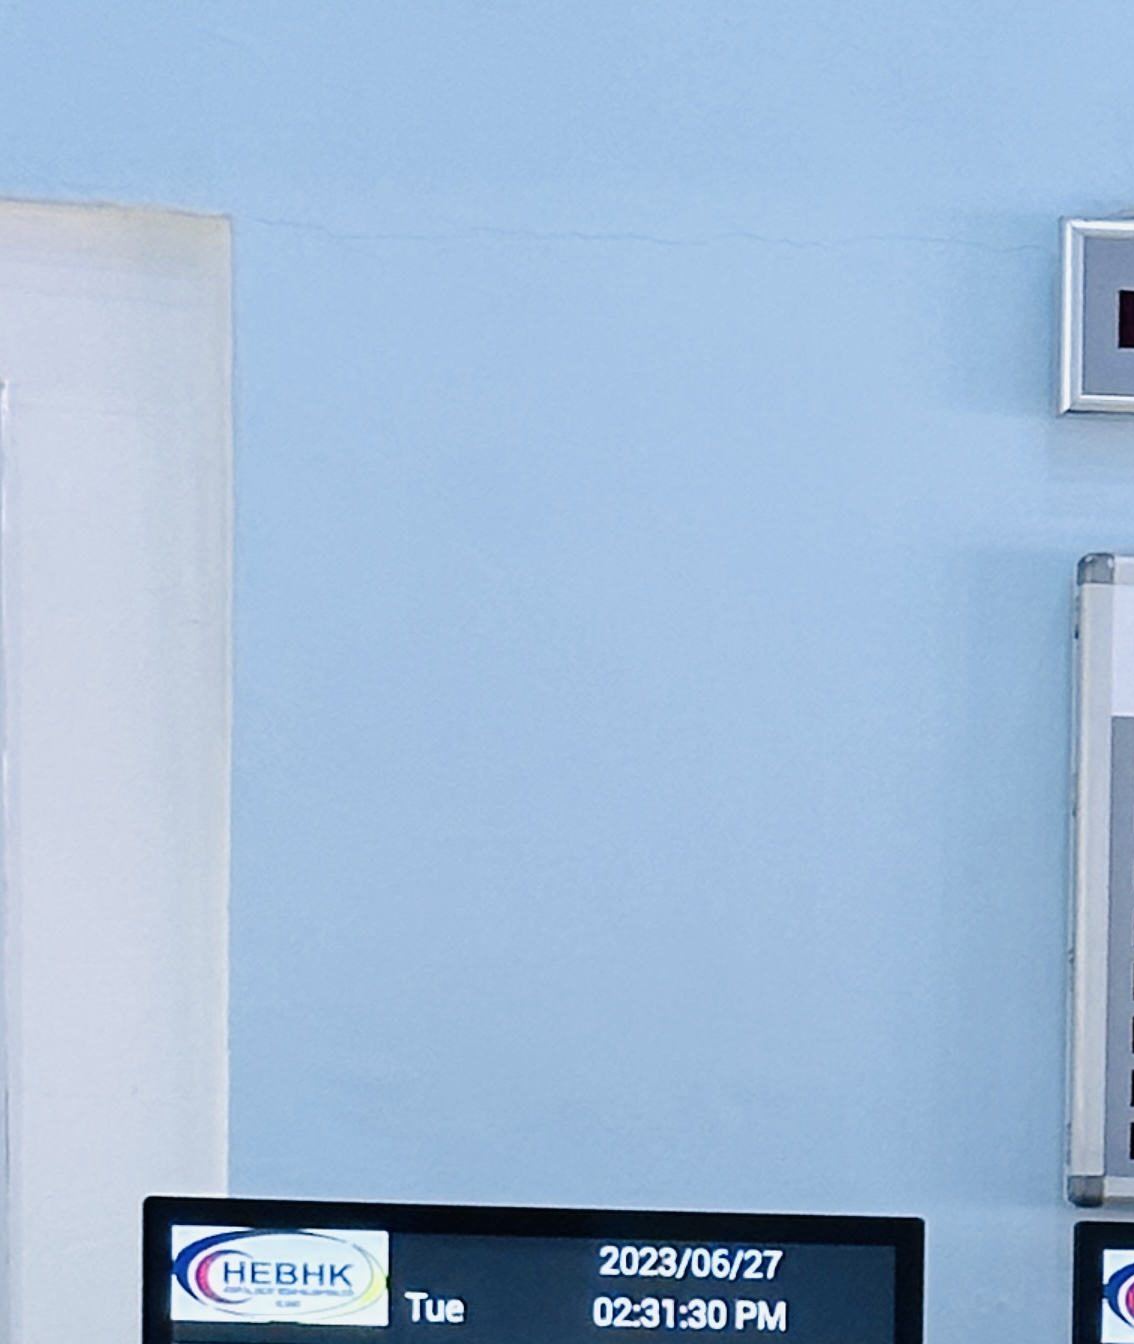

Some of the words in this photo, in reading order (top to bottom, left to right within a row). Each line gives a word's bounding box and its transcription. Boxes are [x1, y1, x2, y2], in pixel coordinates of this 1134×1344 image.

[222, 1261, 353, 1287] HEBHK
[599, 1246, 783, 1280] 2023/06/27
[404, 1291, 465, 1323] Tue
[593, 1297, 727, 1330] 02:31:30
[735, 1301, 787, 1332] PM
